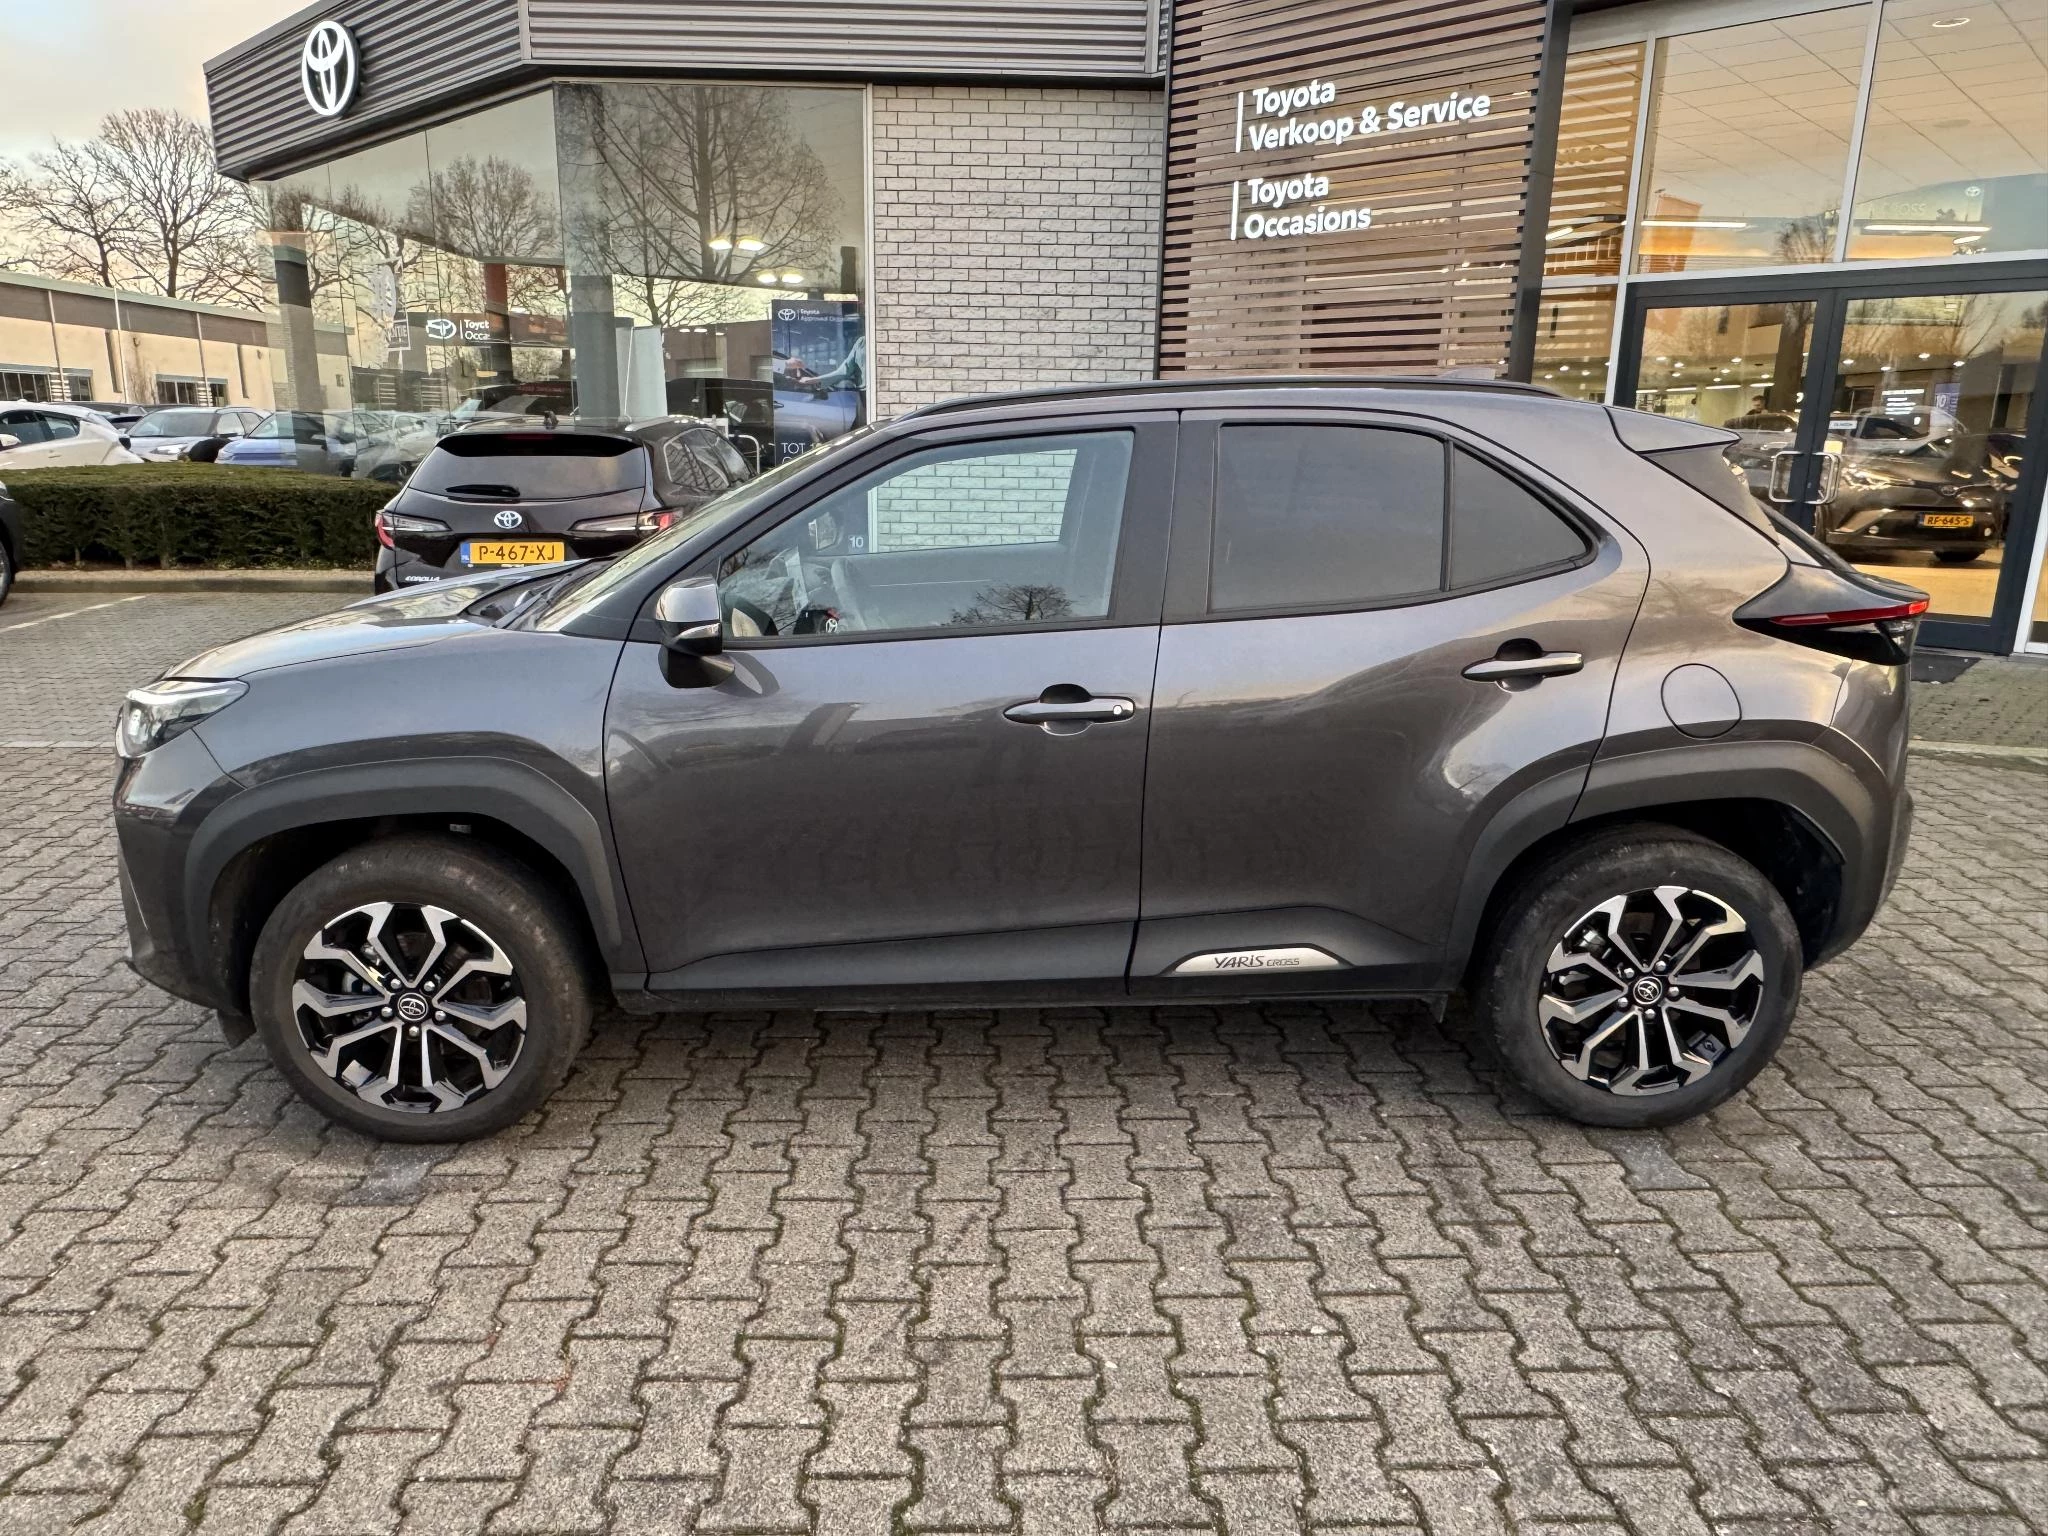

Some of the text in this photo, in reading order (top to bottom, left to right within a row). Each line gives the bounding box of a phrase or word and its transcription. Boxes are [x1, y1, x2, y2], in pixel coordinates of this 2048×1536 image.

[1252, 80, 1335, 117] Toyota
[1249, 92, 1490, 151] Verkoop & Service
[1247, 173, 1329, 209] Toyota
[1244, 206, 1372, 240] Occasions
[781, 442, 806, 454] TOT
[479, 545, 555, 561] P-467-XJ
[849, 535, 864, 549] 10
[1215, 955, 1300, 968] YARIS CROSS
